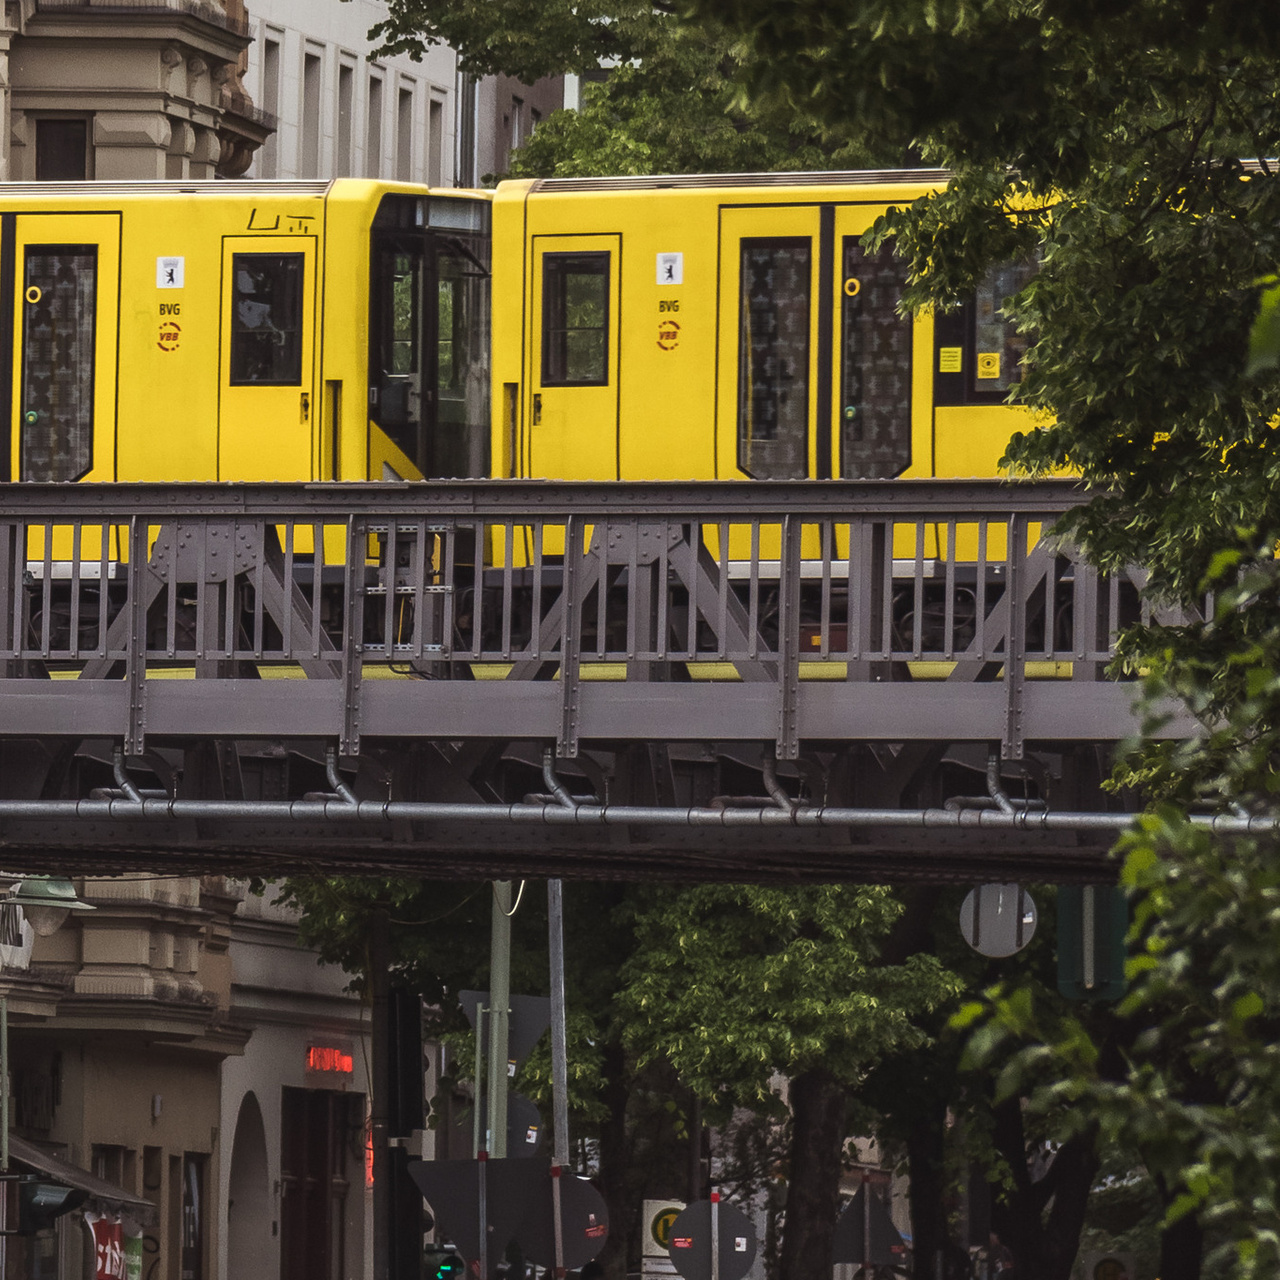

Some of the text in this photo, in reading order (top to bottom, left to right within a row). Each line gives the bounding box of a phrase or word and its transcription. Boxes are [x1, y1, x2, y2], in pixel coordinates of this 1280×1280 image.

[159, 304, 180, 315] BVG
[659, 300, 679, 312] BVG
[159, 333, 179, 341] VBB
